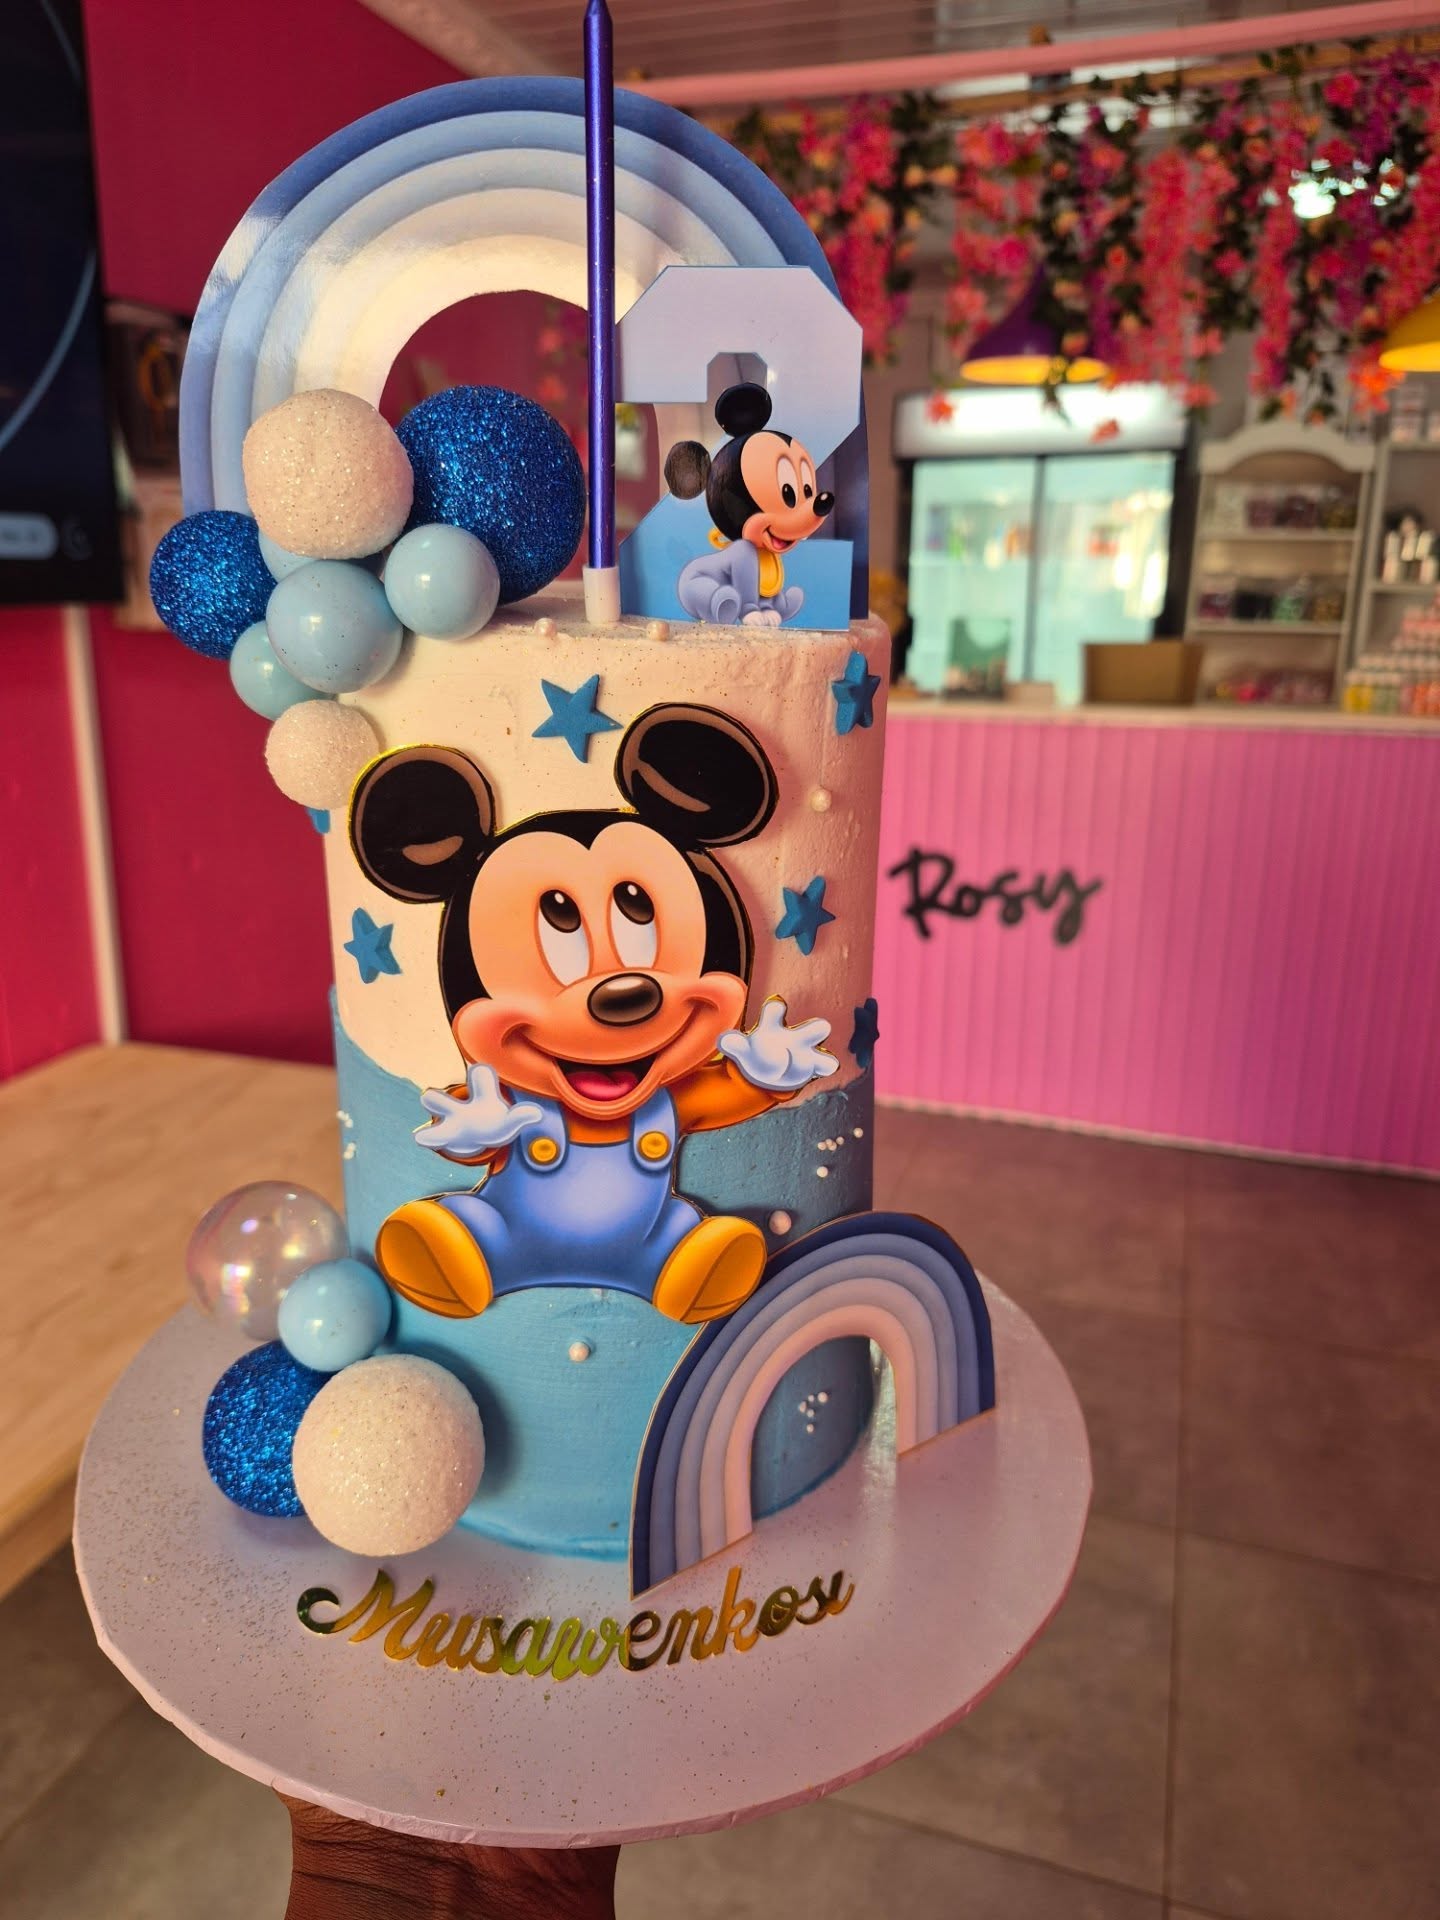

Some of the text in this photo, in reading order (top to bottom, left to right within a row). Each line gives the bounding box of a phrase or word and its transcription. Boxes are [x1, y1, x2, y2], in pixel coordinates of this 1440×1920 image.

[616, 265, 863, 631] 2
[887, 845, 1103, 946] Rosy
[297, 1566, 856, 1682] Musawenkosi
